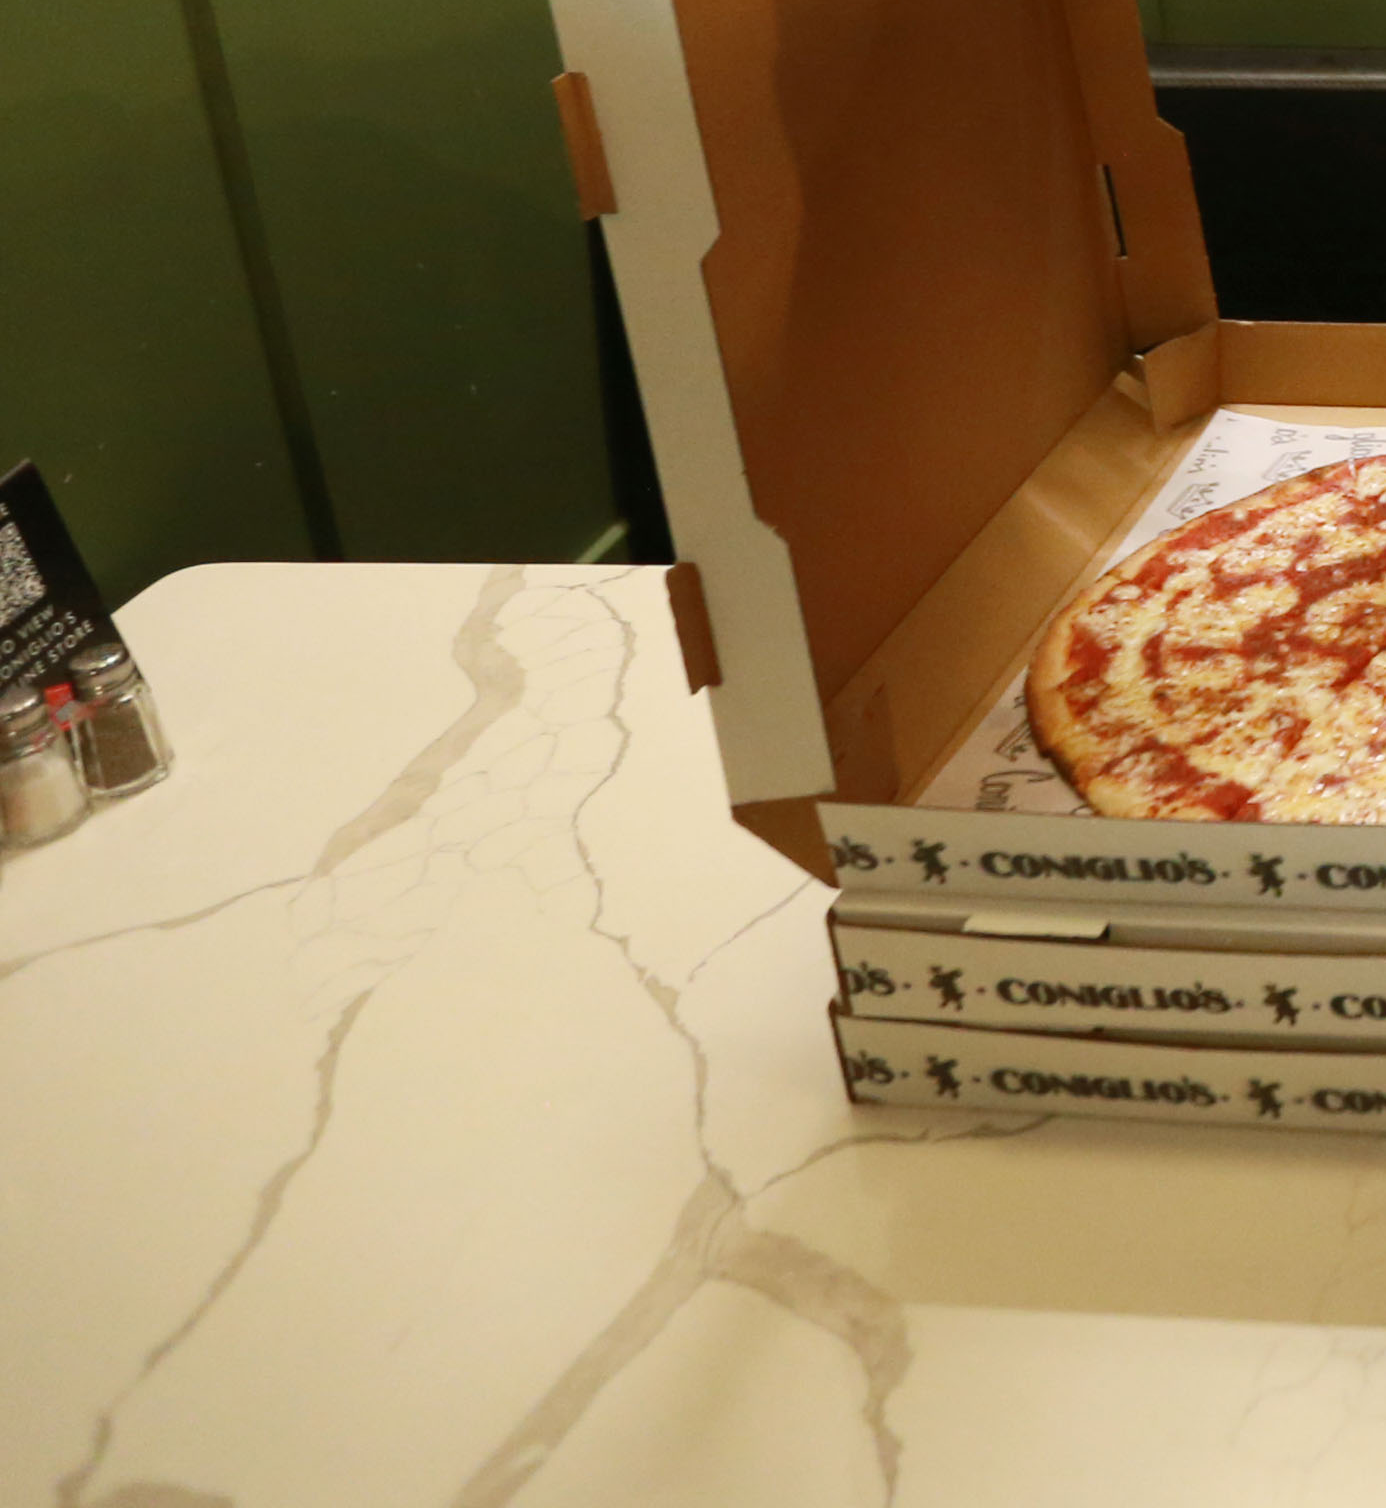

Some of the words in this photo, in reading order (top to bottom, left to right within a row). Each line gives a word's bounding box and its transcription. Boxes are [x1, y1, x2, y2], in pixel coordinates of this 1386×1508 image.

[17, 604, 54, 639] VIEW
[47, 619, 95, 664] STORE
[980, 850, 1217, 886] CONIGLIO'S
[996, 977, 1231, 1015] CONIGLIO'S
[991, 1066, 1218, 1108] CONIGLIO'S
